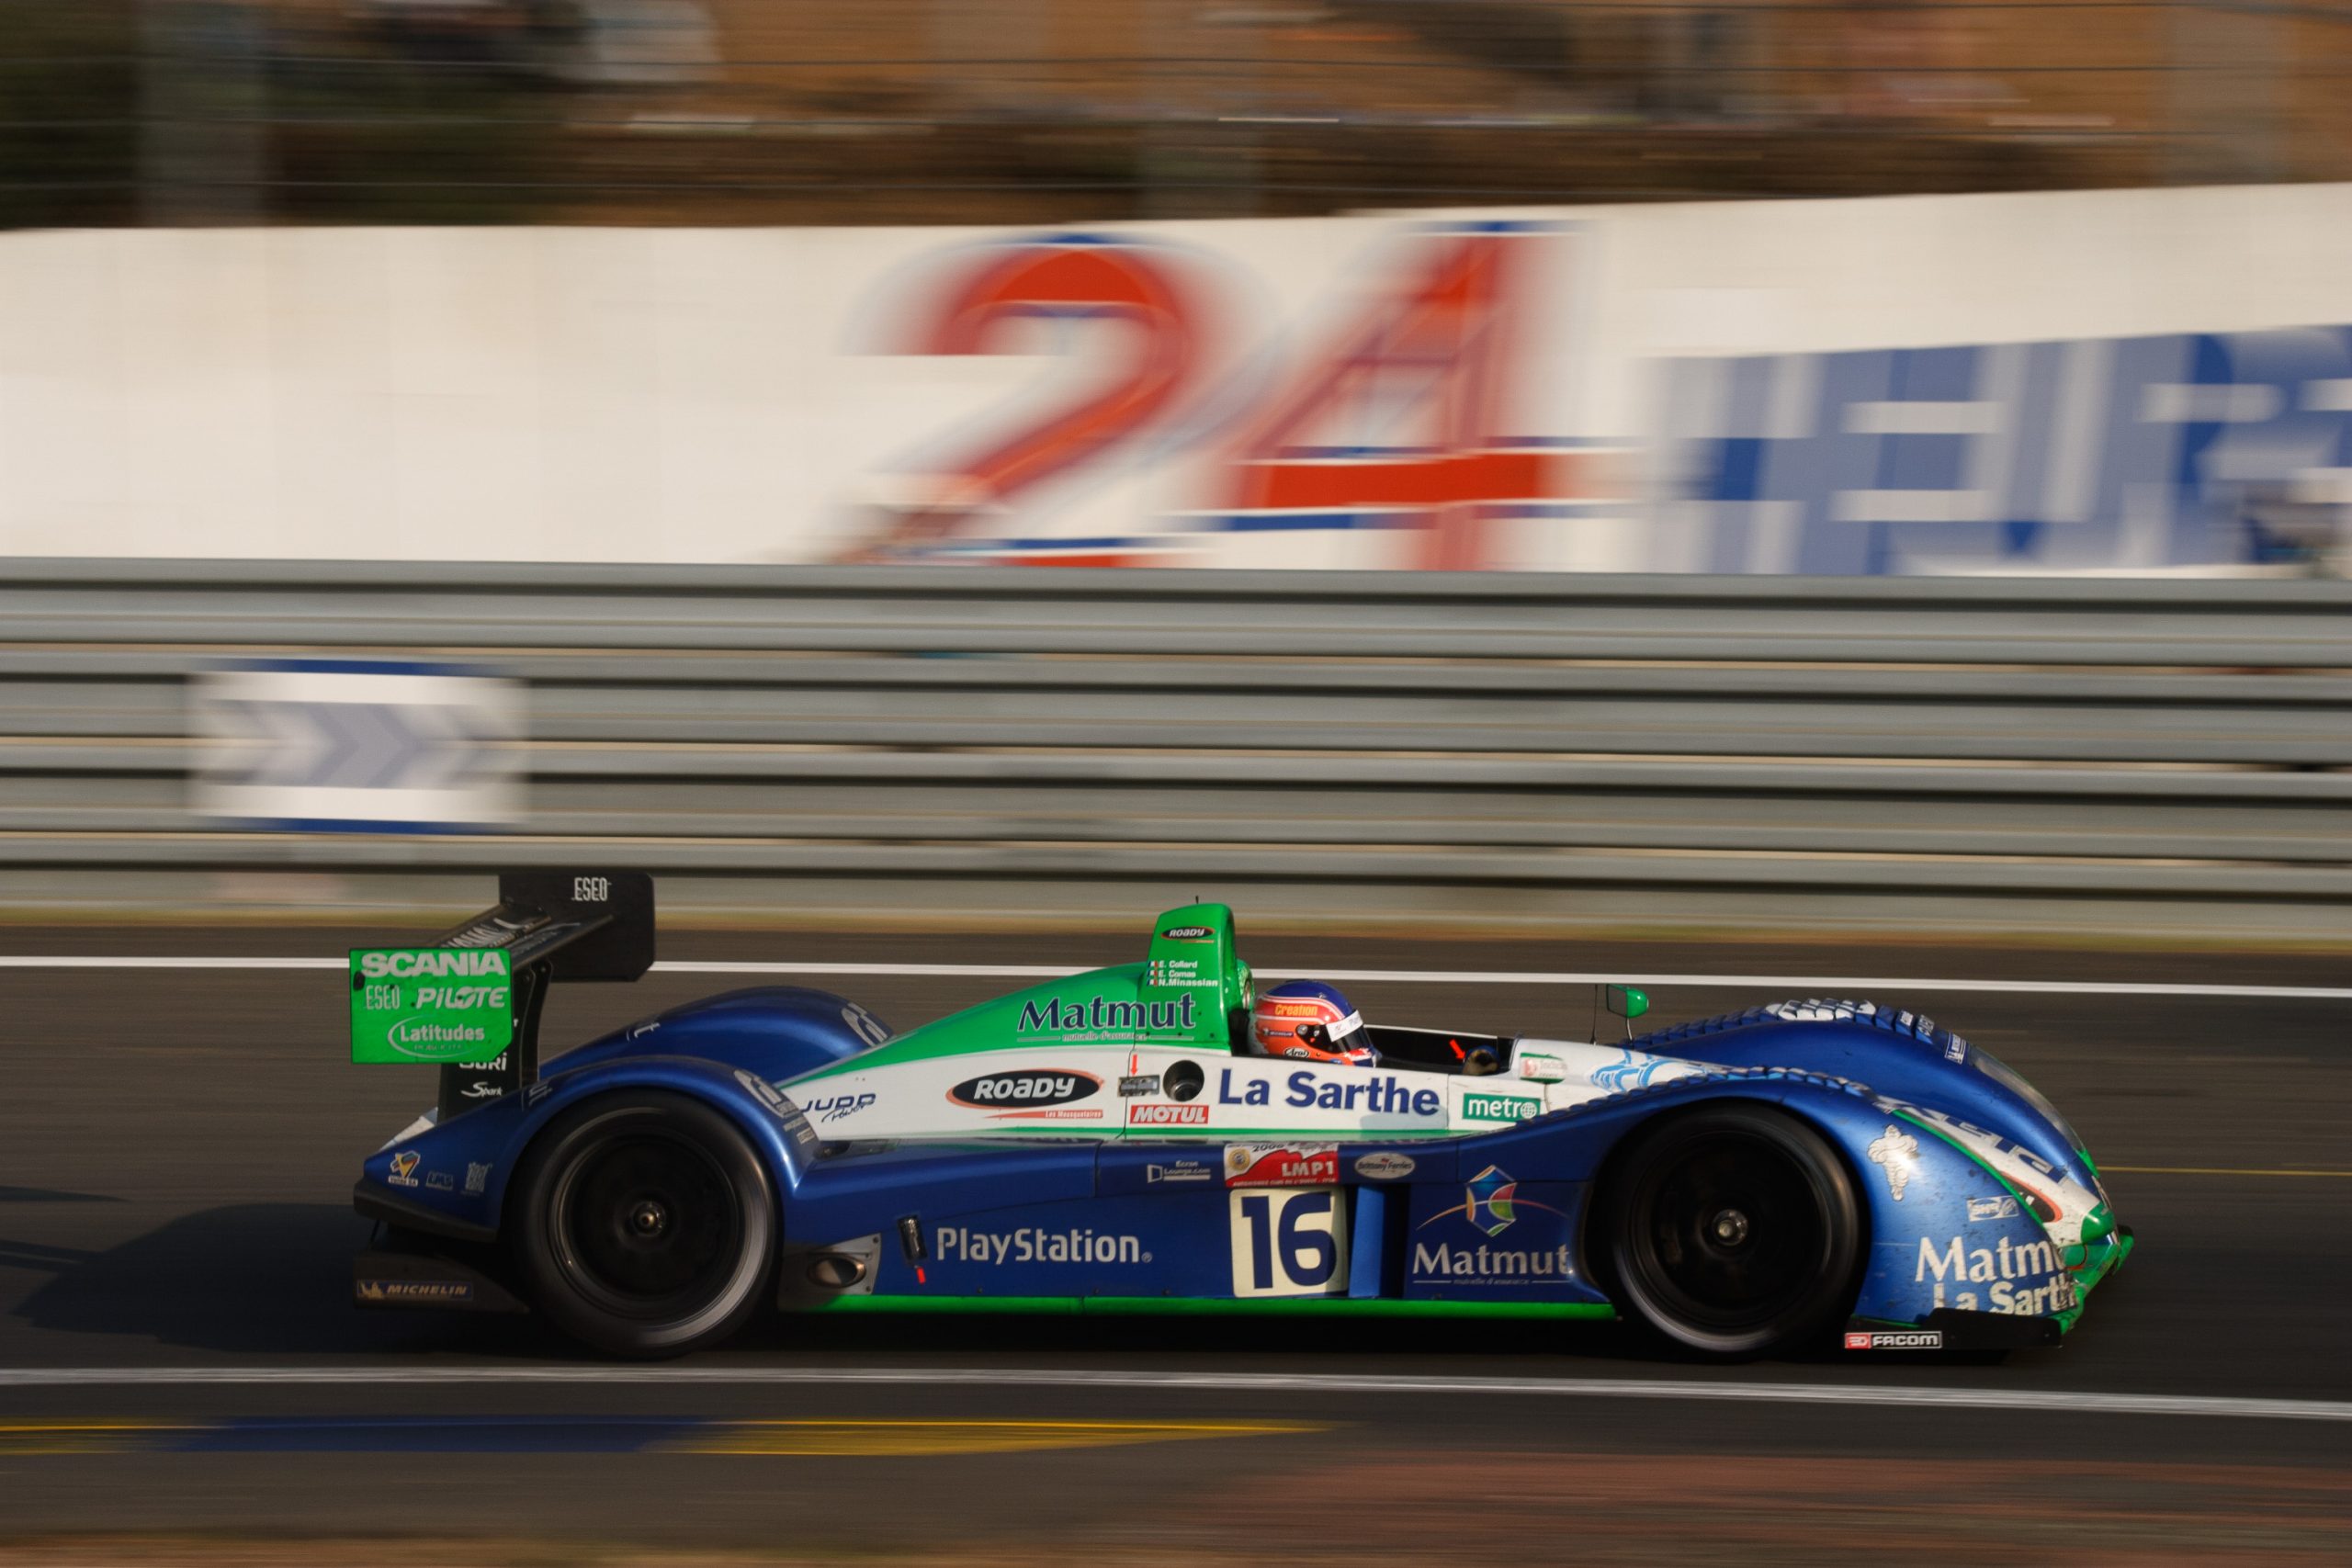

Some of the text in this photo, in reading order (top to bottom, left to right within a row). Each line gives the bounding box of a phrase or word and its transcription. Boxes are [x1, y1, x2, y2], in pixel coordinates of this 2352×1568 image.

[859, 223, 1622, 573] 24
[573, 876, 608, 902] ESEO
[361, 952, 507, 978] SCANIA
[1169, 960, 1199, 969] Collard
[365, 984, 401, 1010] ESEO
[1017, 992, 1196, 1032] Matmut
[400, 1023, 485, 1043] Latitudes
[460, 1081, 503, 1098] Spark
[1219, 1068, 1441, 1116] La Sarthe
[799, 1092, 876, 1114] JUDD
[1468, 1098, 1538, 1120] metro
[1133, 1106, 1206, 1123] MOTUL
[1282, 1160, 1334, 1178] LMP1
[1240, 1190, 1338, 1291] 16
[1412, 1242, 1572, 1275] Matmut
[387, 1283, 468, 1295] MICHELIN
[1871, 1334, 1939, 1347] FACOM
